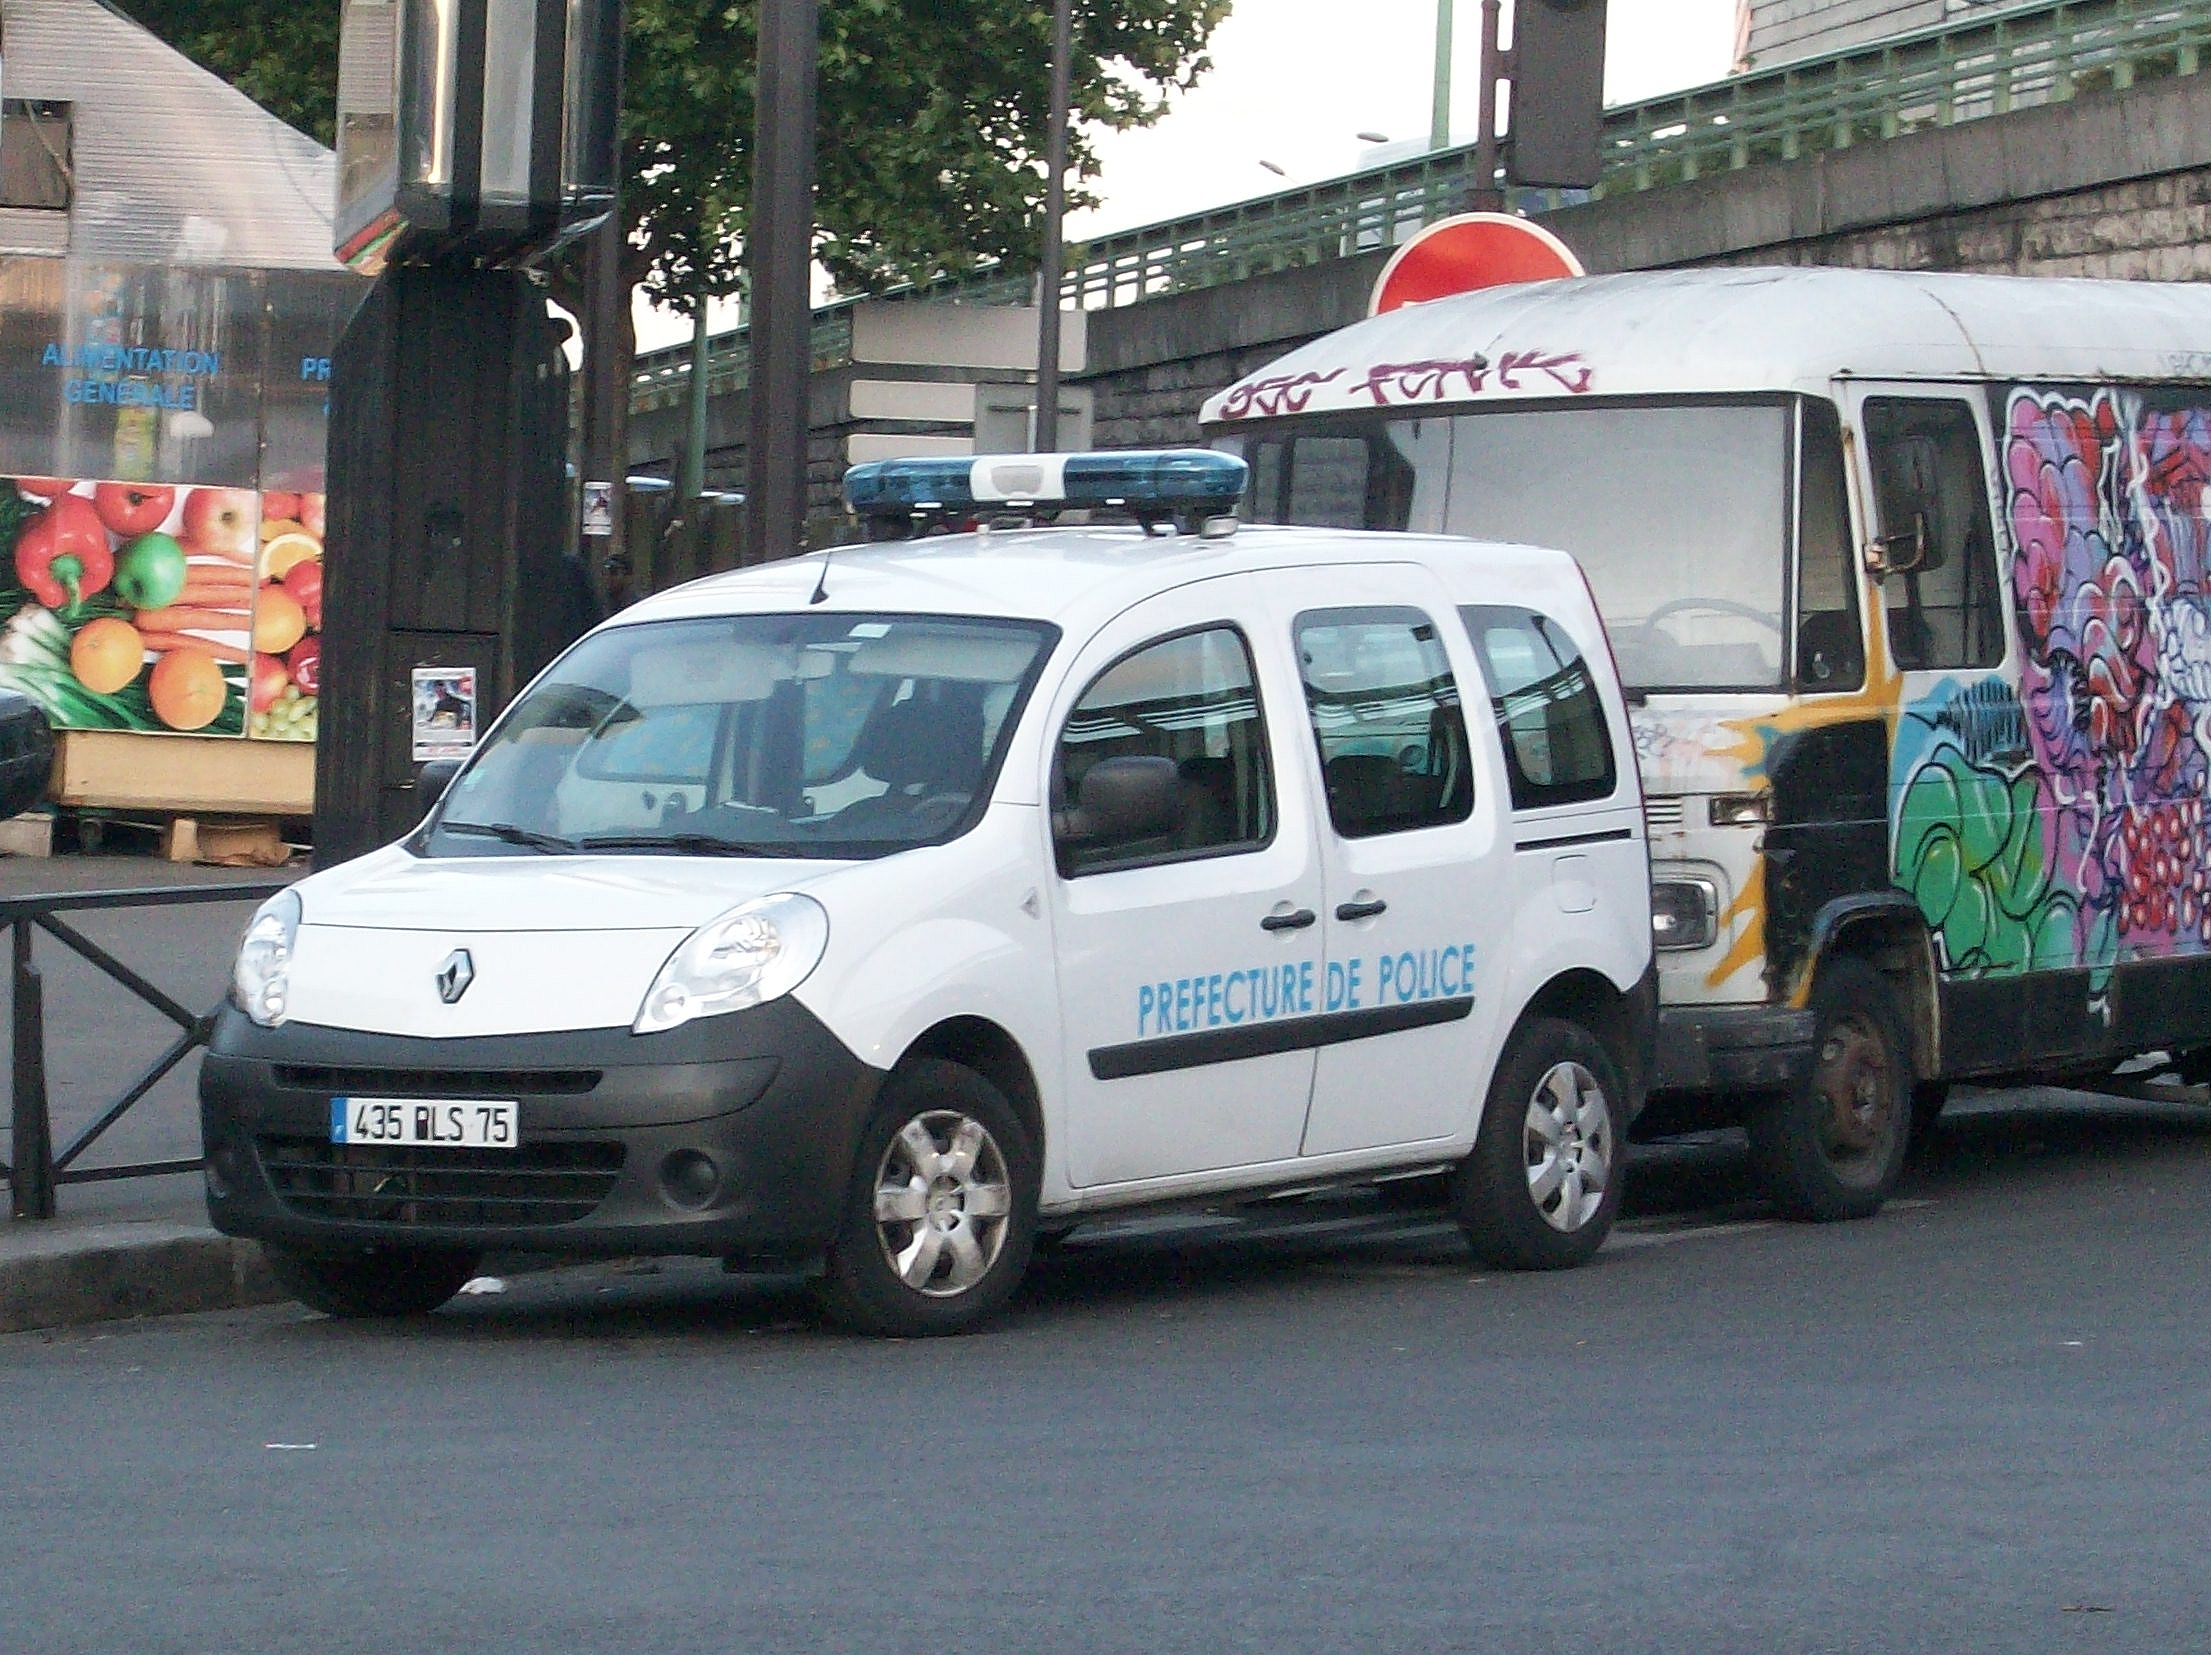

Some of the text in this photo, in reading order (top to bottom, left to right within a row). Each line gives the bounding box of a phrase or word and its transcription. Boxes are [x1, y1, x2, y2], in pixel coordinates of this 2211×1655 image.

[42, 343, 220, 375] ALIMENTATION
[1138, 943, 1475, 1036] PREFECTURE DE POLICE
[354, 1105, 401, 1139] 435
[476, 1107, 508, 1143] 75
